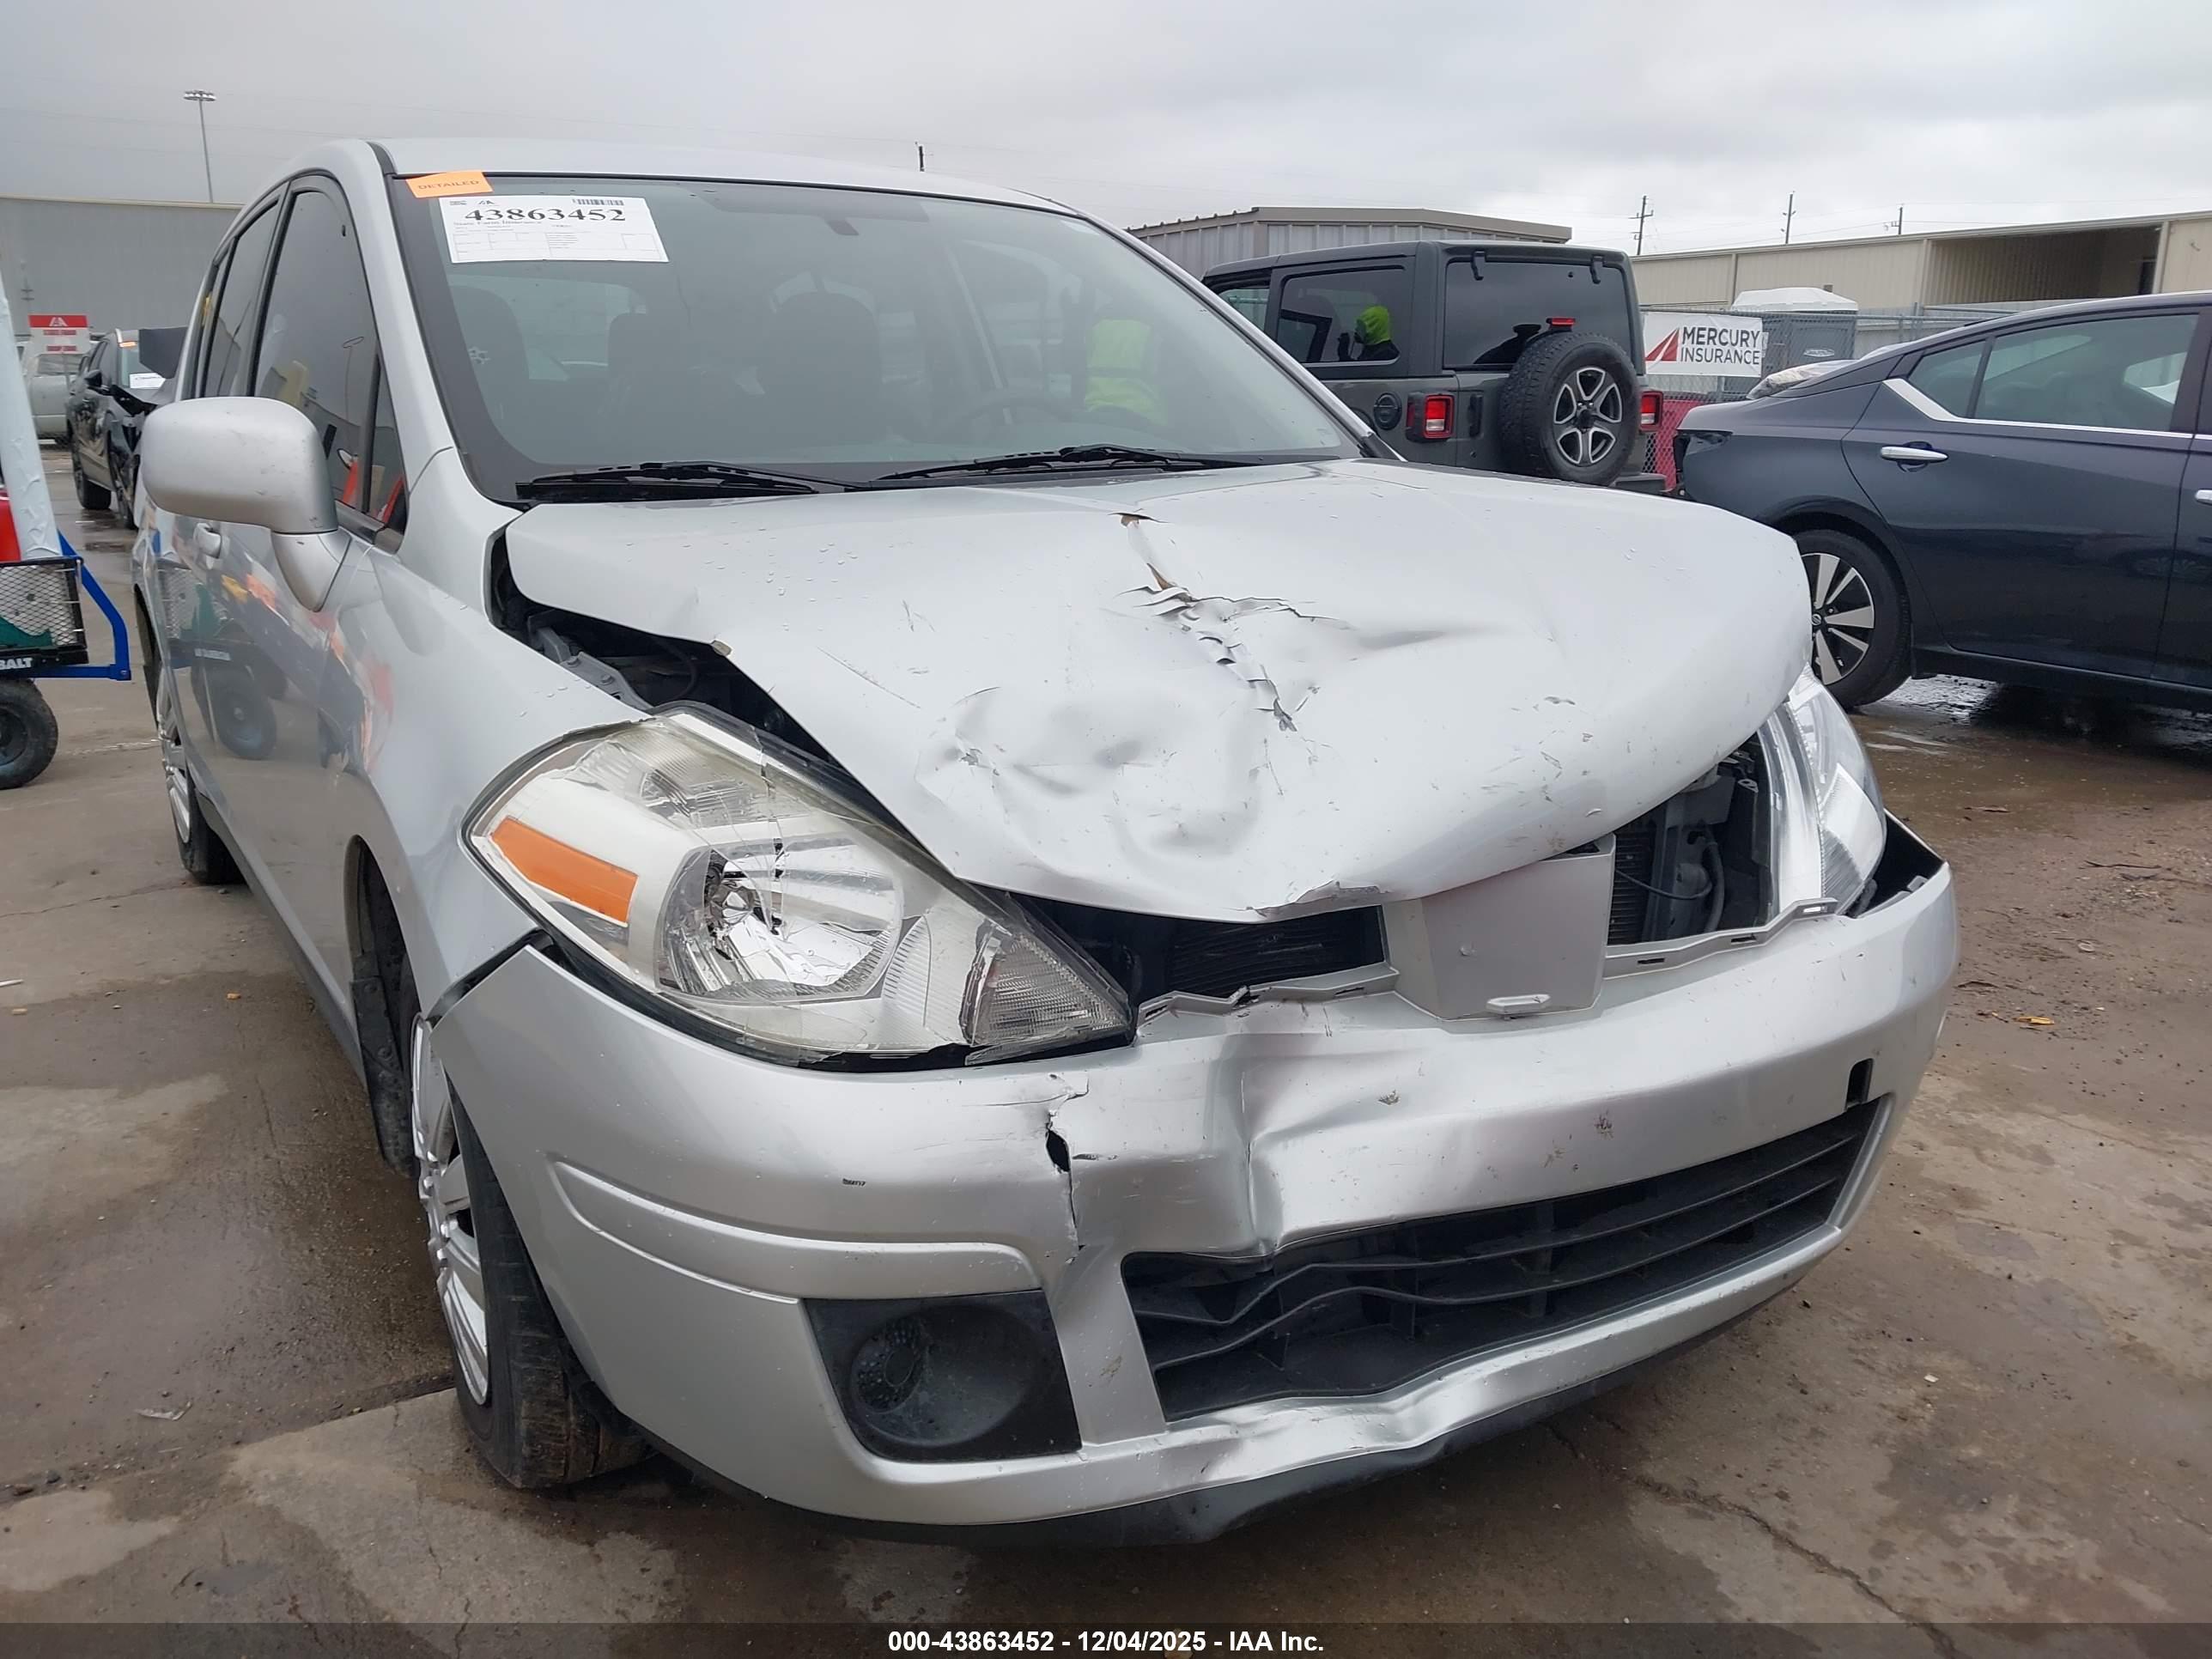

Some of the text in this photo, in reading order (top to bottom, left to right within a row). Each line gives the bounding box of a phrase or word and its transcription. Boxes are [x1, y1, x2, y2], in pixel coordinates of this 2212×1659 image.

[417, 179, 480, 190] DETAILED
[465, 208, 626, 222] 43863452
[1681, 325, 1761, 349] MERCURY
[1680, 346, 1760, 366] INSURANCE
